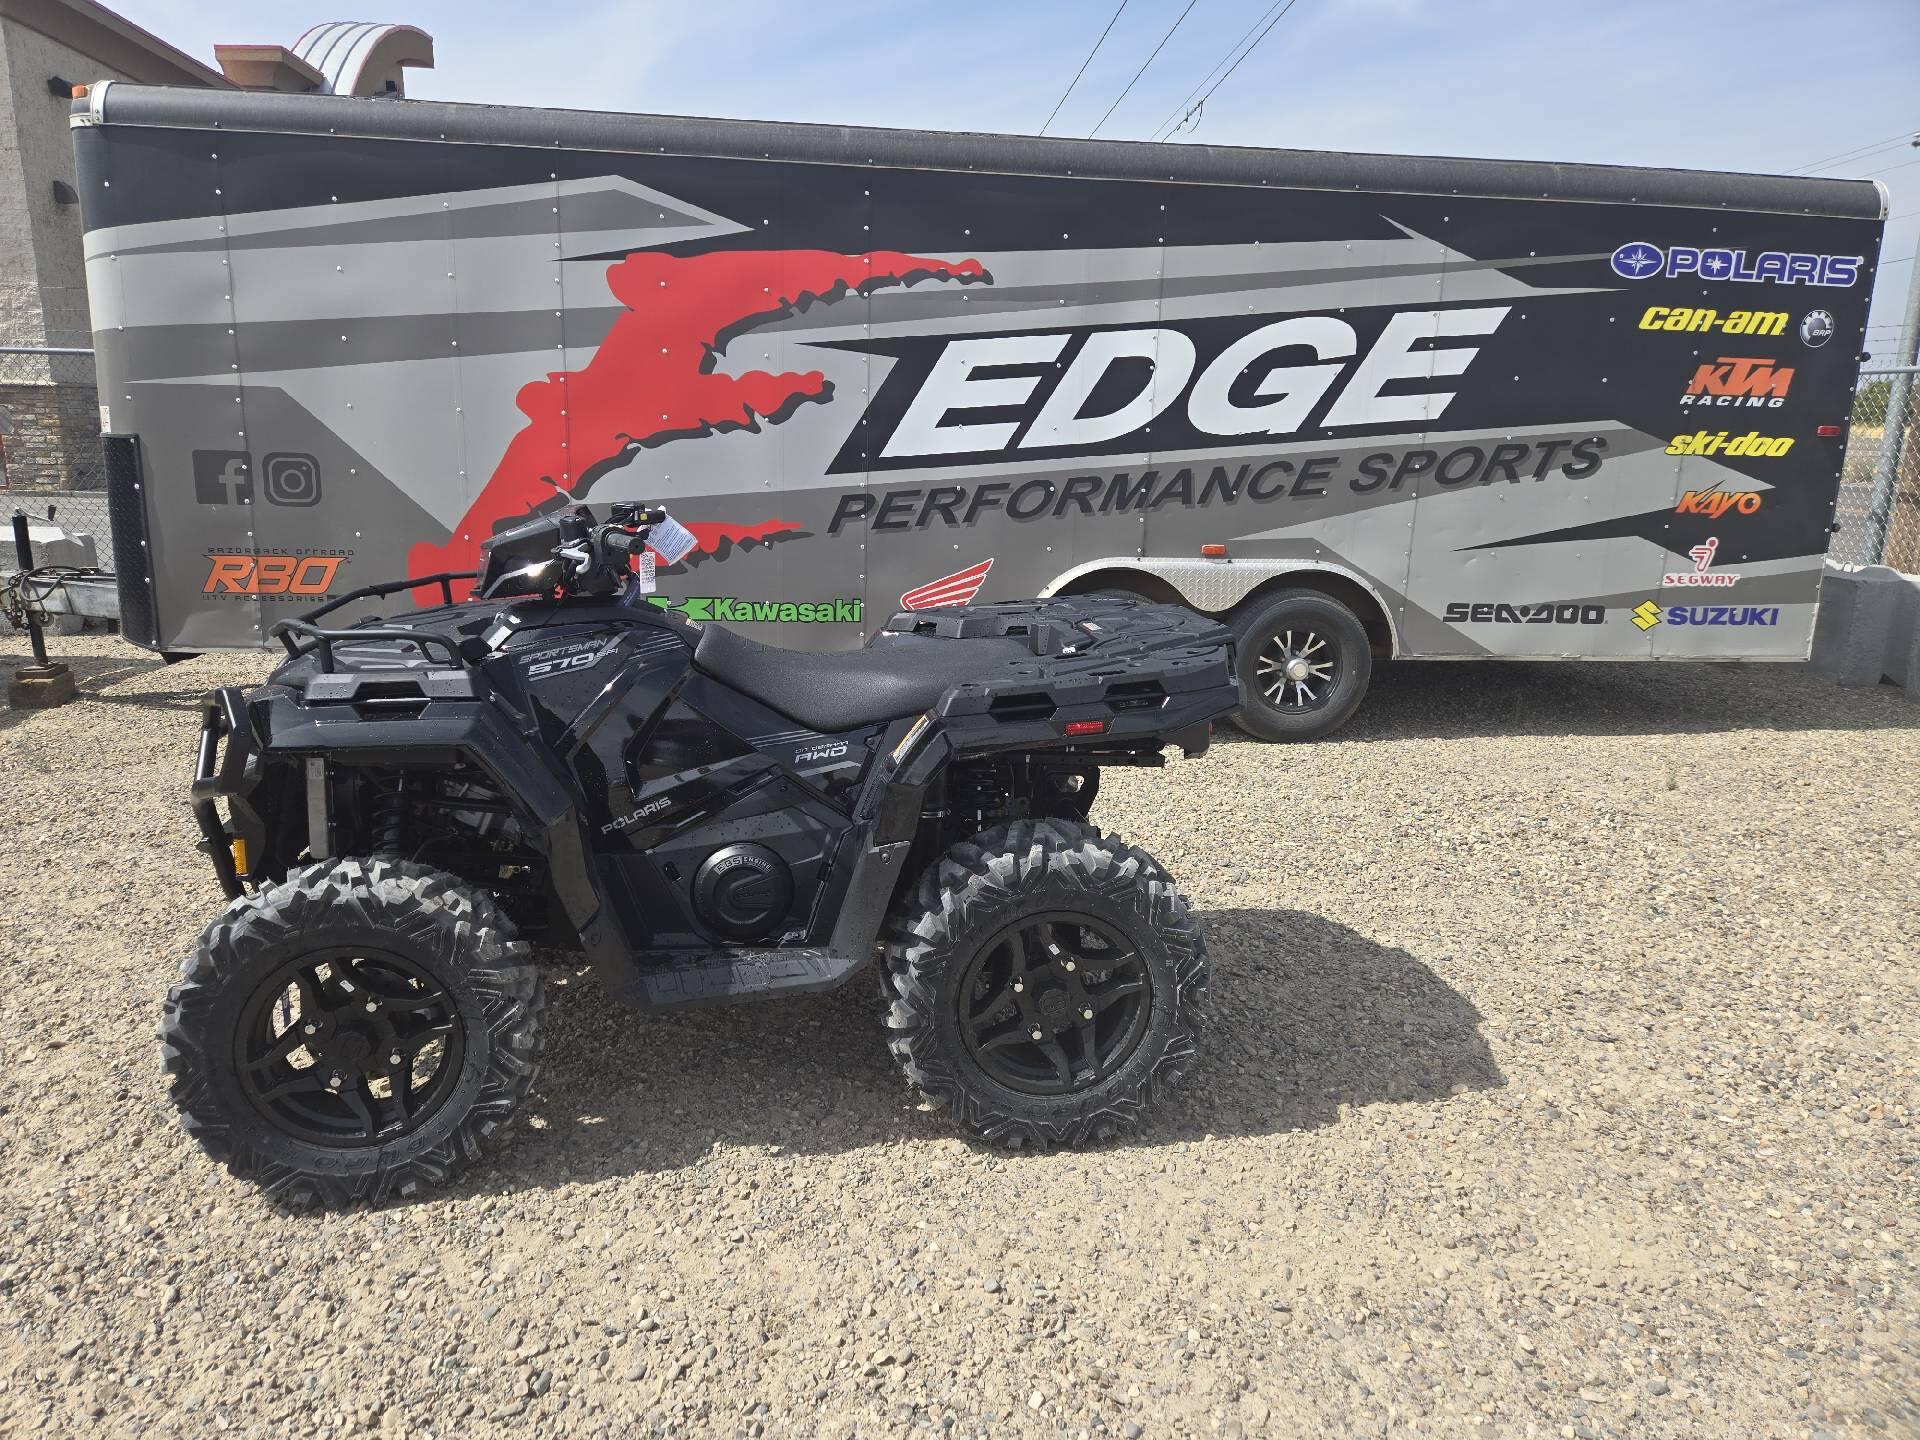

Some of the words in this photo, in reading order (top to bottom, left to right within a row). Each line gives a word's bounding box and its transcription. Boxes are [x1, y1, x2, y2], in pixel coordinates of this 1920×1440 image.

[1666, 246, 1864, 287] POLARIS
[1812, 329, 1832, 337] BRP
[878, 306, 1512, 458] EDGE
[1685, 357, 1795, 397] KTM
[1680, 395, 1785, 408] RACING
[1664, 431, 1795, 457] ski-doo
[826, 456, 1339, 536] PERFORMANCE
[1348, 437, 1608, 494] SPORTS
[1675, 480, 1762, 519] KAYO
[295, 548, 355, 556] OFFROAD
[202, 554, 348, 594] RBO
[1663, 574, 1738, 586] SEGWAY
[713, 597, 863, 623] Kawasaki
[1667, 606, 1780, 626] SUZUKI
[519, 638, 607, 664] SPORTSMAN
[528, 652, 595, 676] 570
[794, 745, 848, 764] AWD
[601, 796, 672, 835] POLARIS
